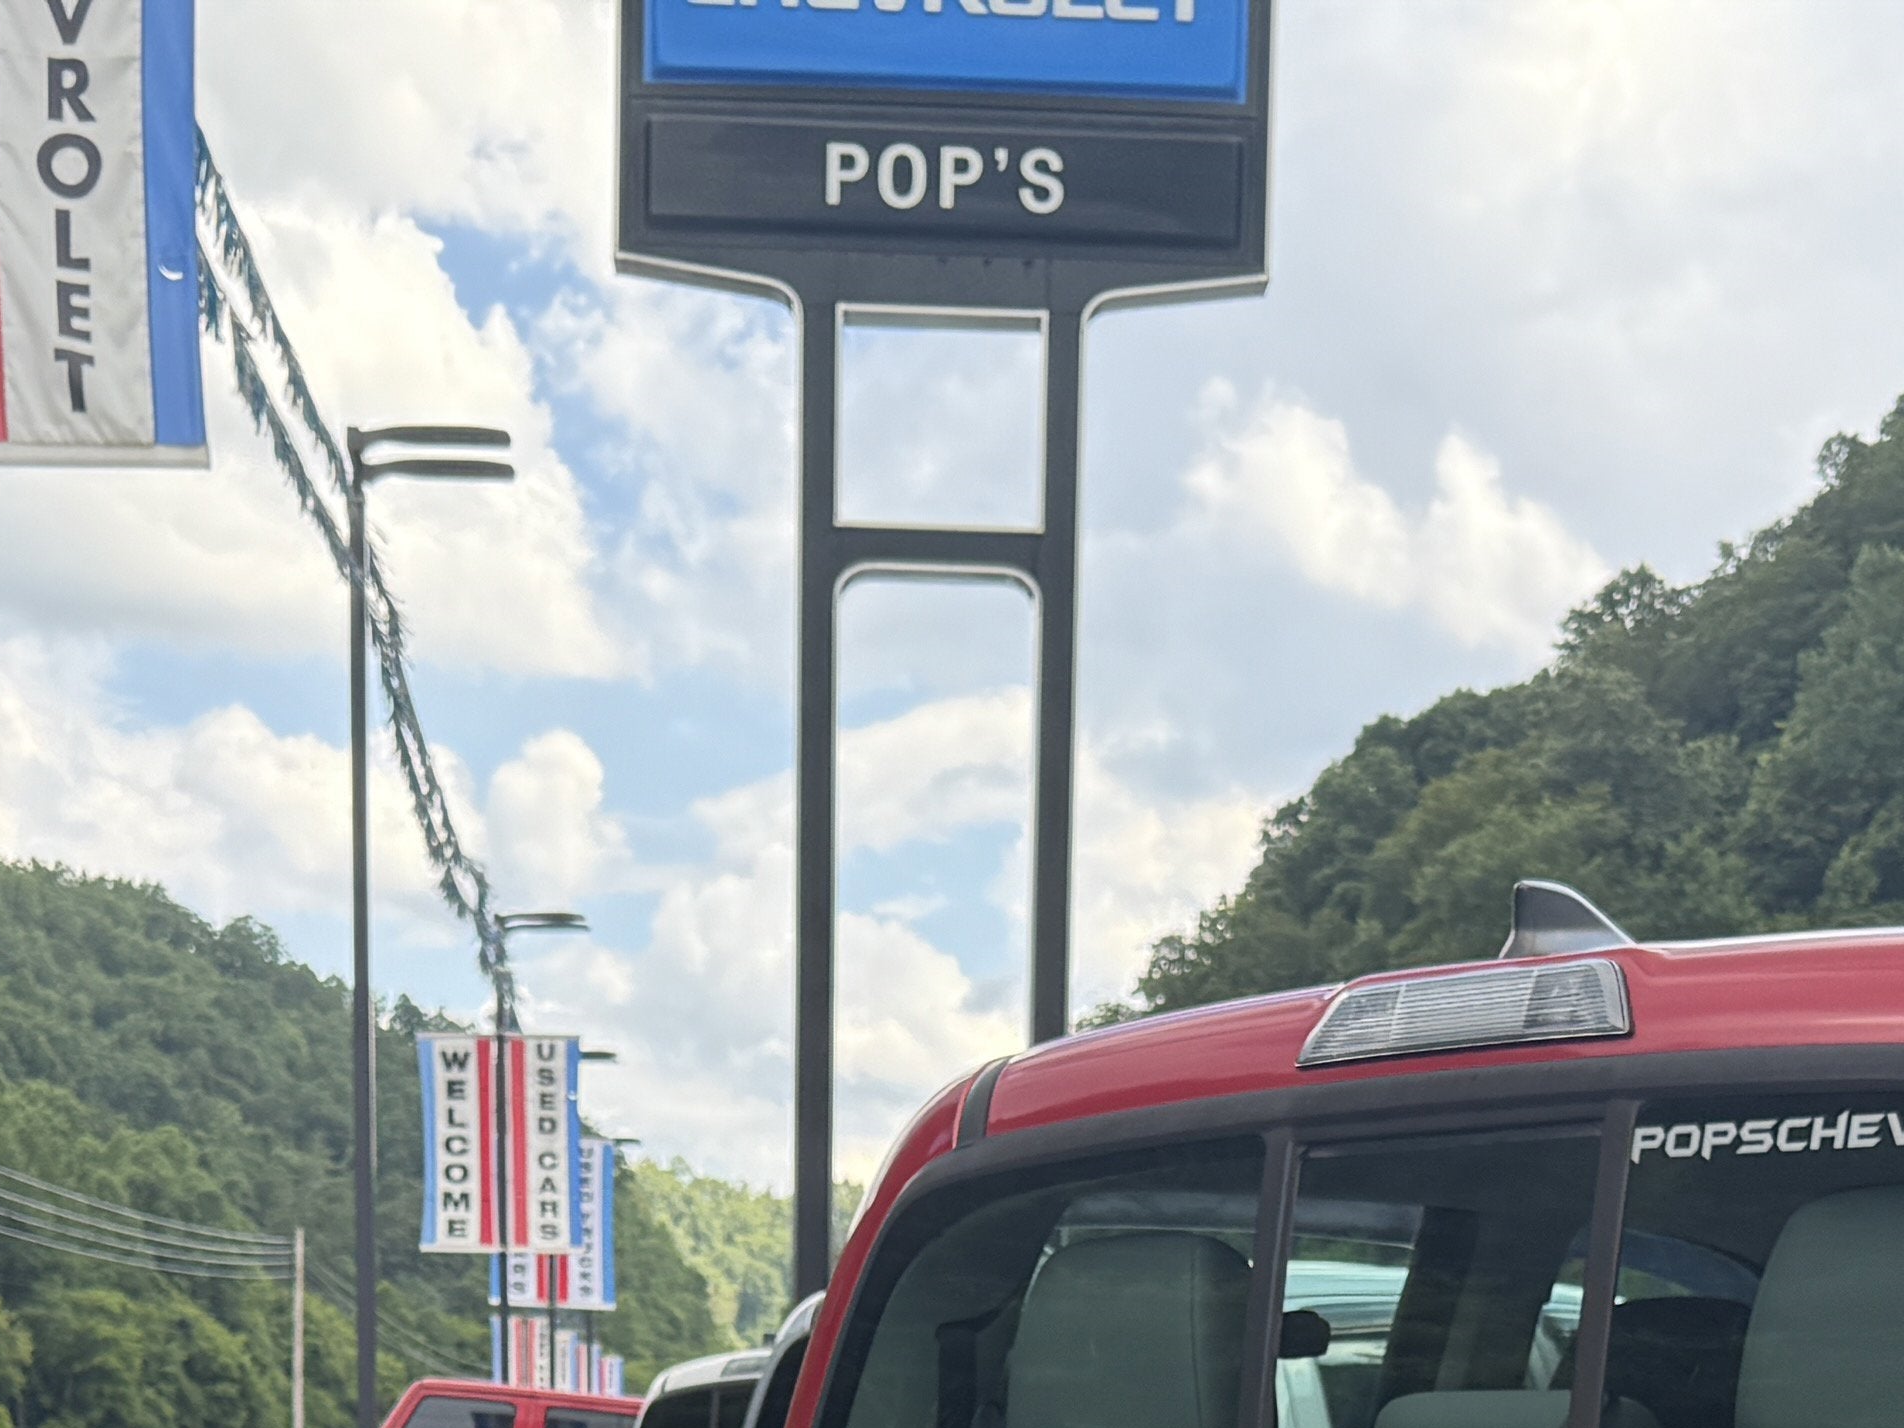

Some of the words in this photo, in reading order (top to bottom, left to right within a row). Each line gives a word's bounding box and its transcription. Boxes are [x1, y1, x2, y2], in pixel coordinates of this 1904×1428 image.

[824, 142, 1065, 214] POP'S
[535, 1043, 558, 1136] USED
[441, 1050, 471, 1238] WELCOME
[537, 1152, 561, 1241] CARS
